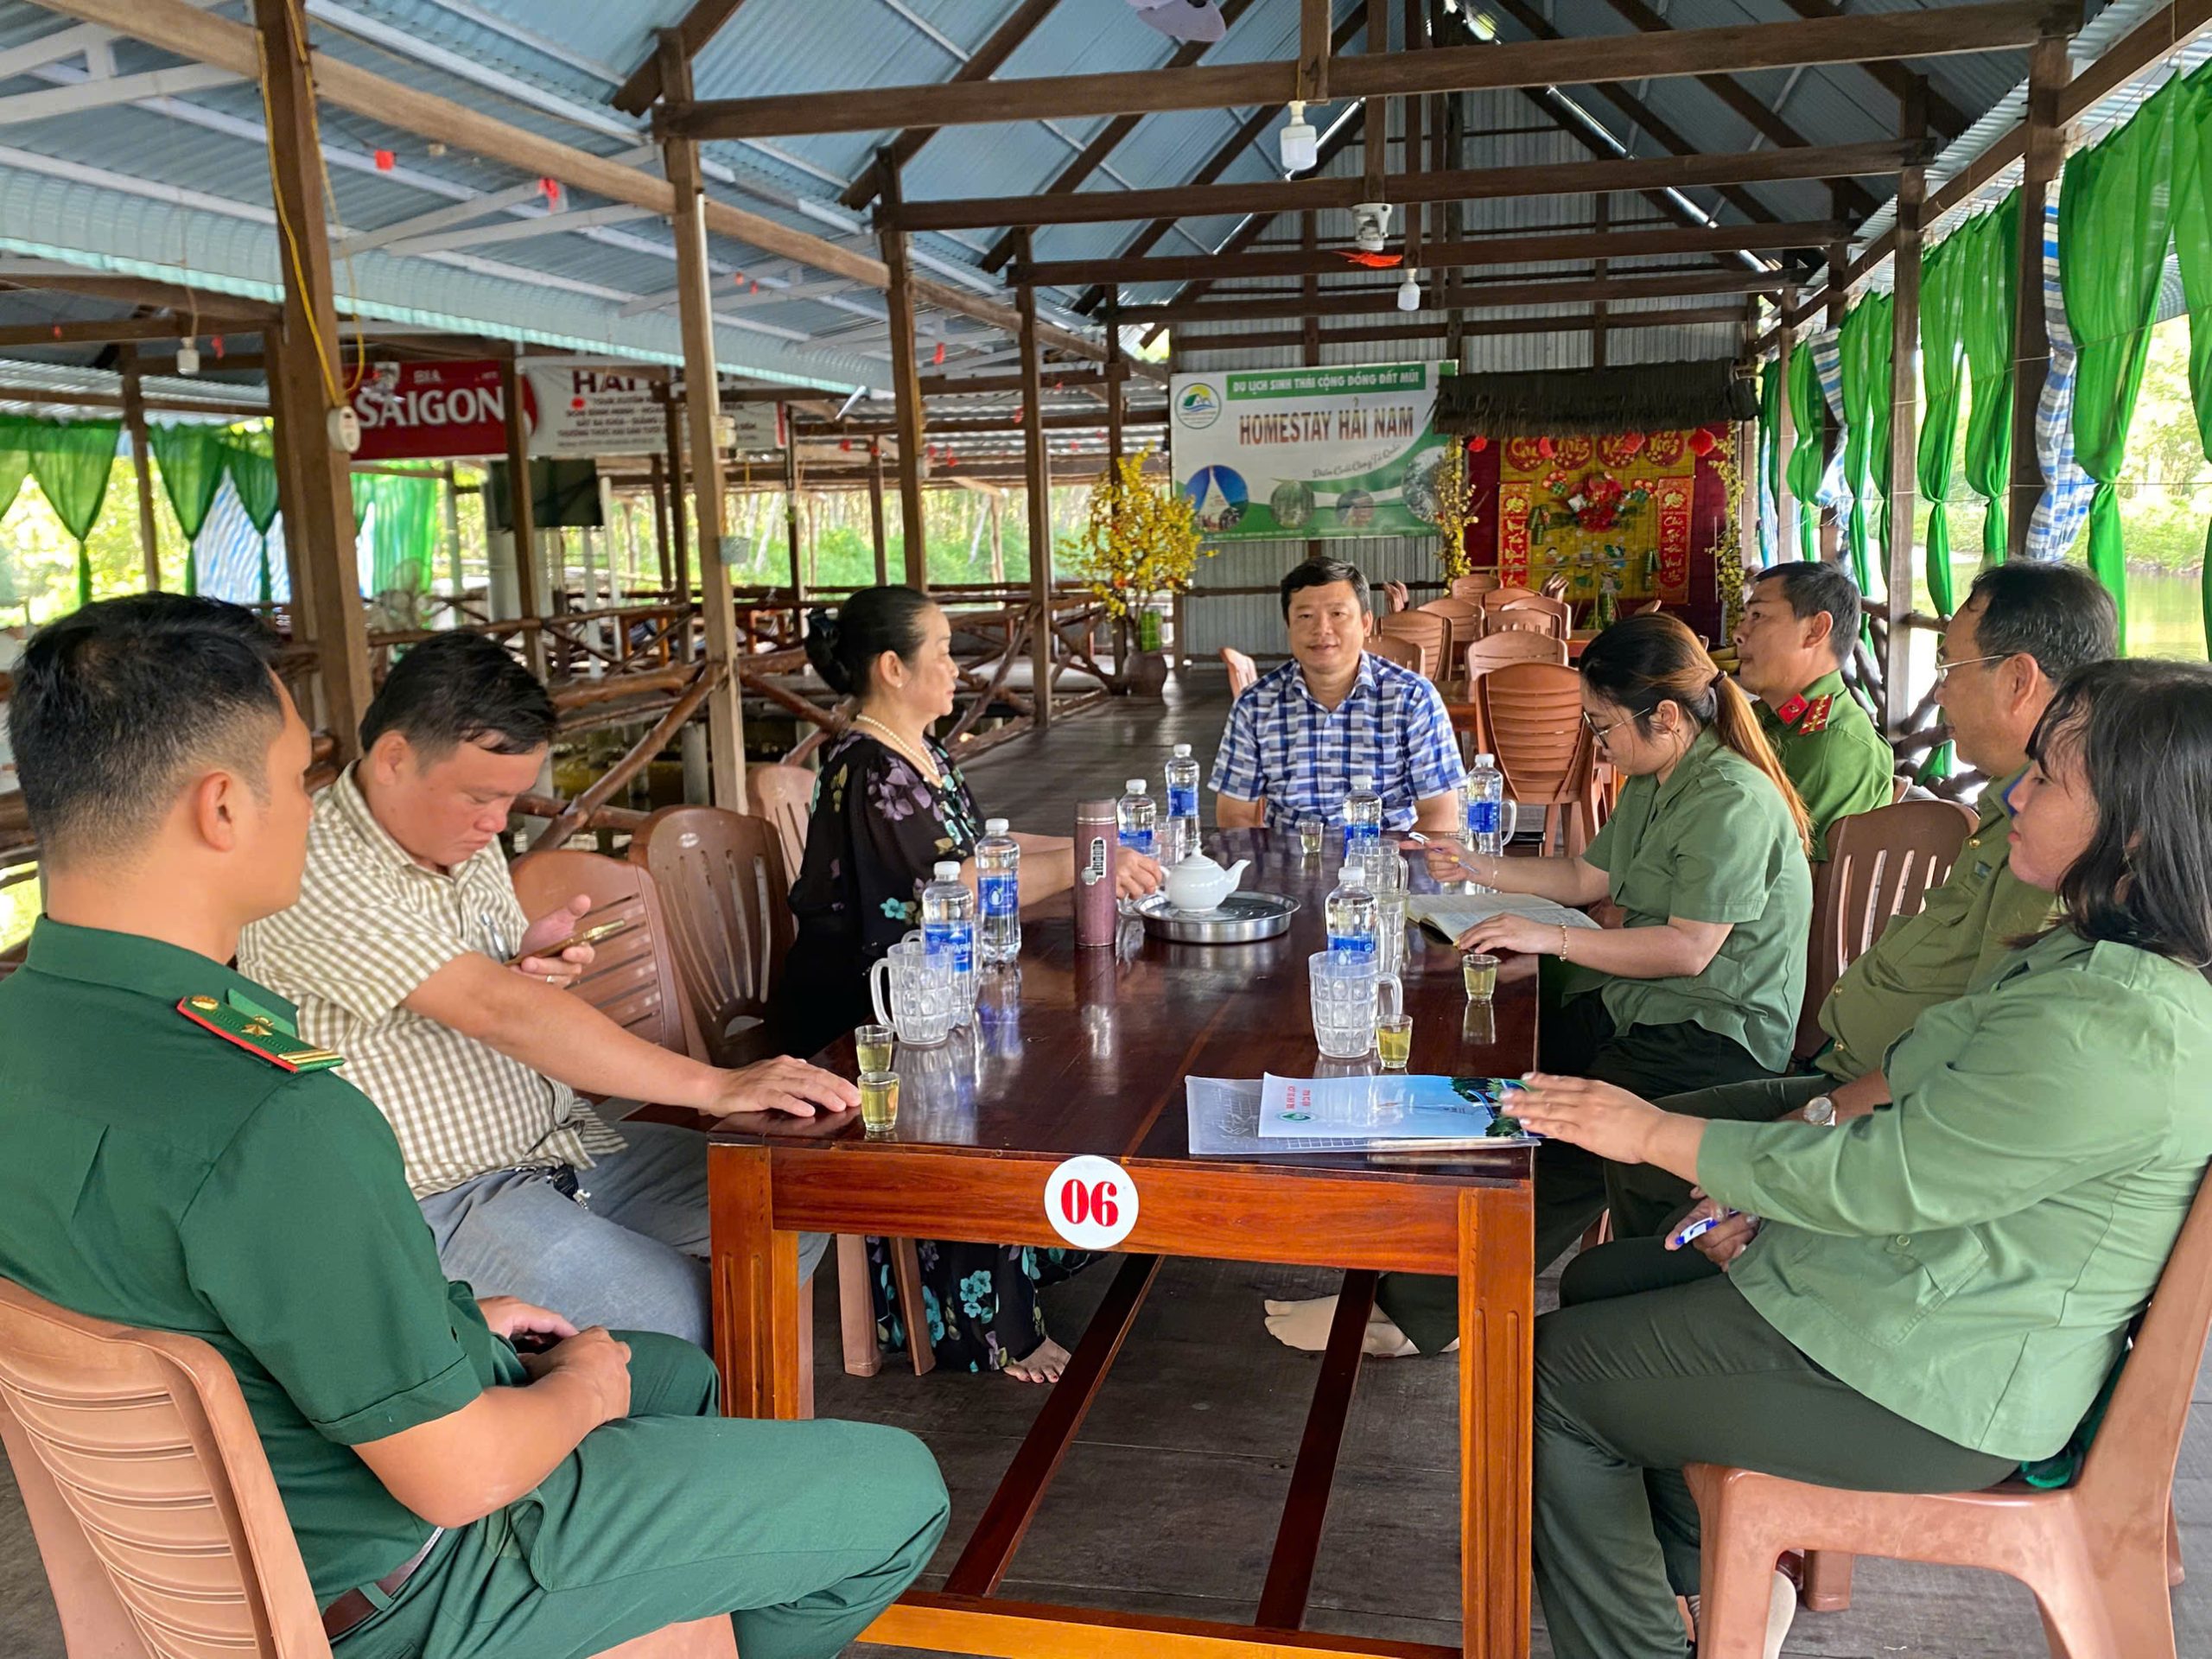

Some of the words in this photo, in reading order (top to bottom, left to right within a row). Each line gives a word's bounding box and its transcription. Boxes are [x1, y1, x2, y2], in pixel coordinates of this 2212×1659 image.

[414, 370, 442, 384] BIA
[1249, 380, 1268, 396] LỊCH
[1269, 378, 1293, 391] SINH
[1318, 374, 1345, 392] CỘNG
[355, 385, 505, 429] SAIGON
[1239, 410, 1332, 447] HOMESTAY
[1338, 397, 1368, 441] HẢI
[1374, 406, 1414, 438] NAM
[1060, 1178, 1119, 1228] 06
